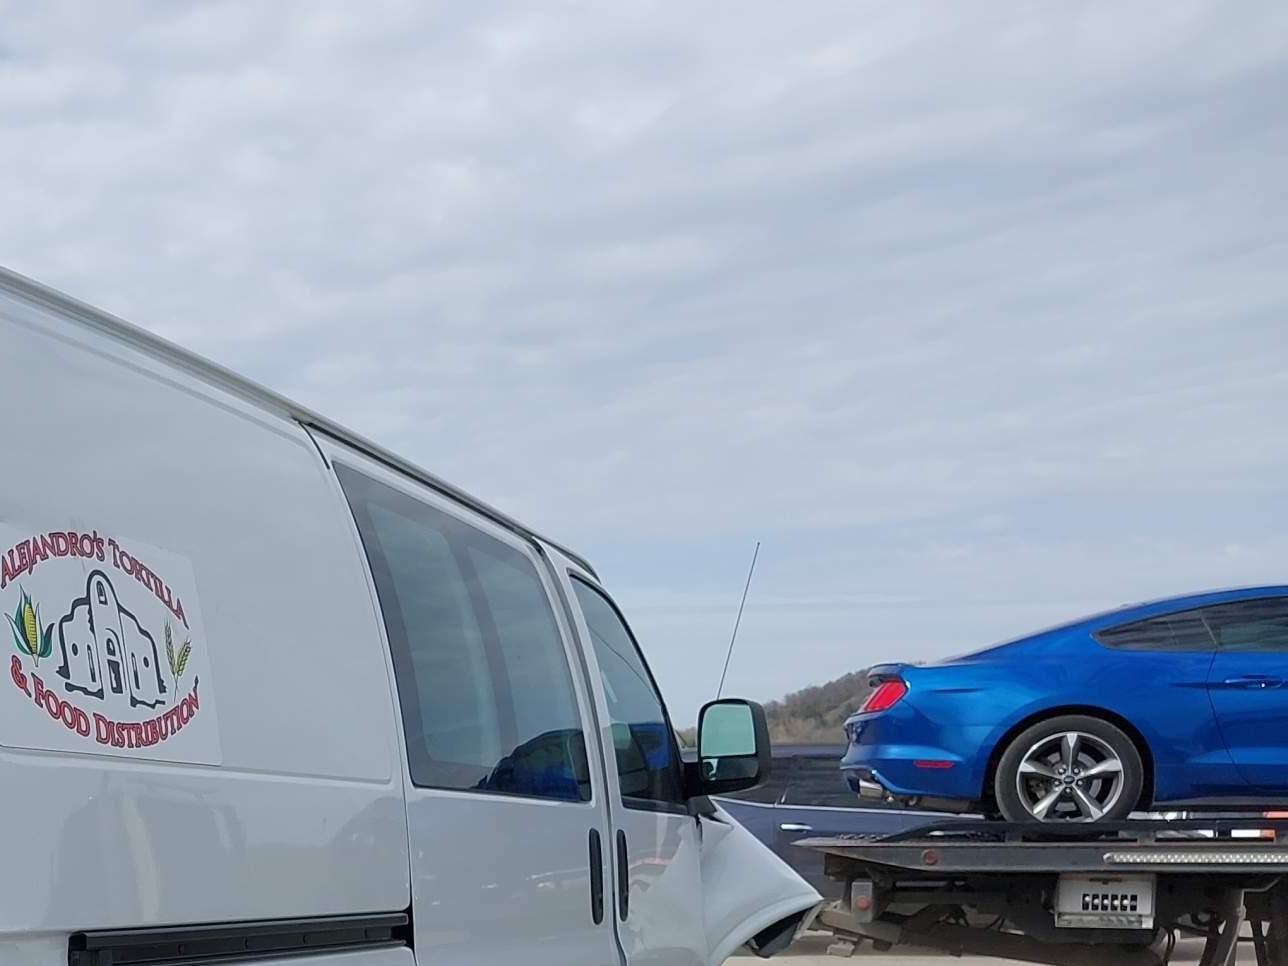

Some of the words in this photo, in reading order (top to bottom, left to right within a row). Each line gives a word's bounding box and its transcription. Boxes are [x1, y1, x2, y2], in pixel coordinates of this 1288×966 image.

[0, 530, 105, 590] ALEJANDRO'S
[108, 537, 190, 630] TORTILLA
[10, 654, 32, 698] &
[31, 671, 90, 738] FOOD
[92, 675, 200, 750] DISTRIBUTION
